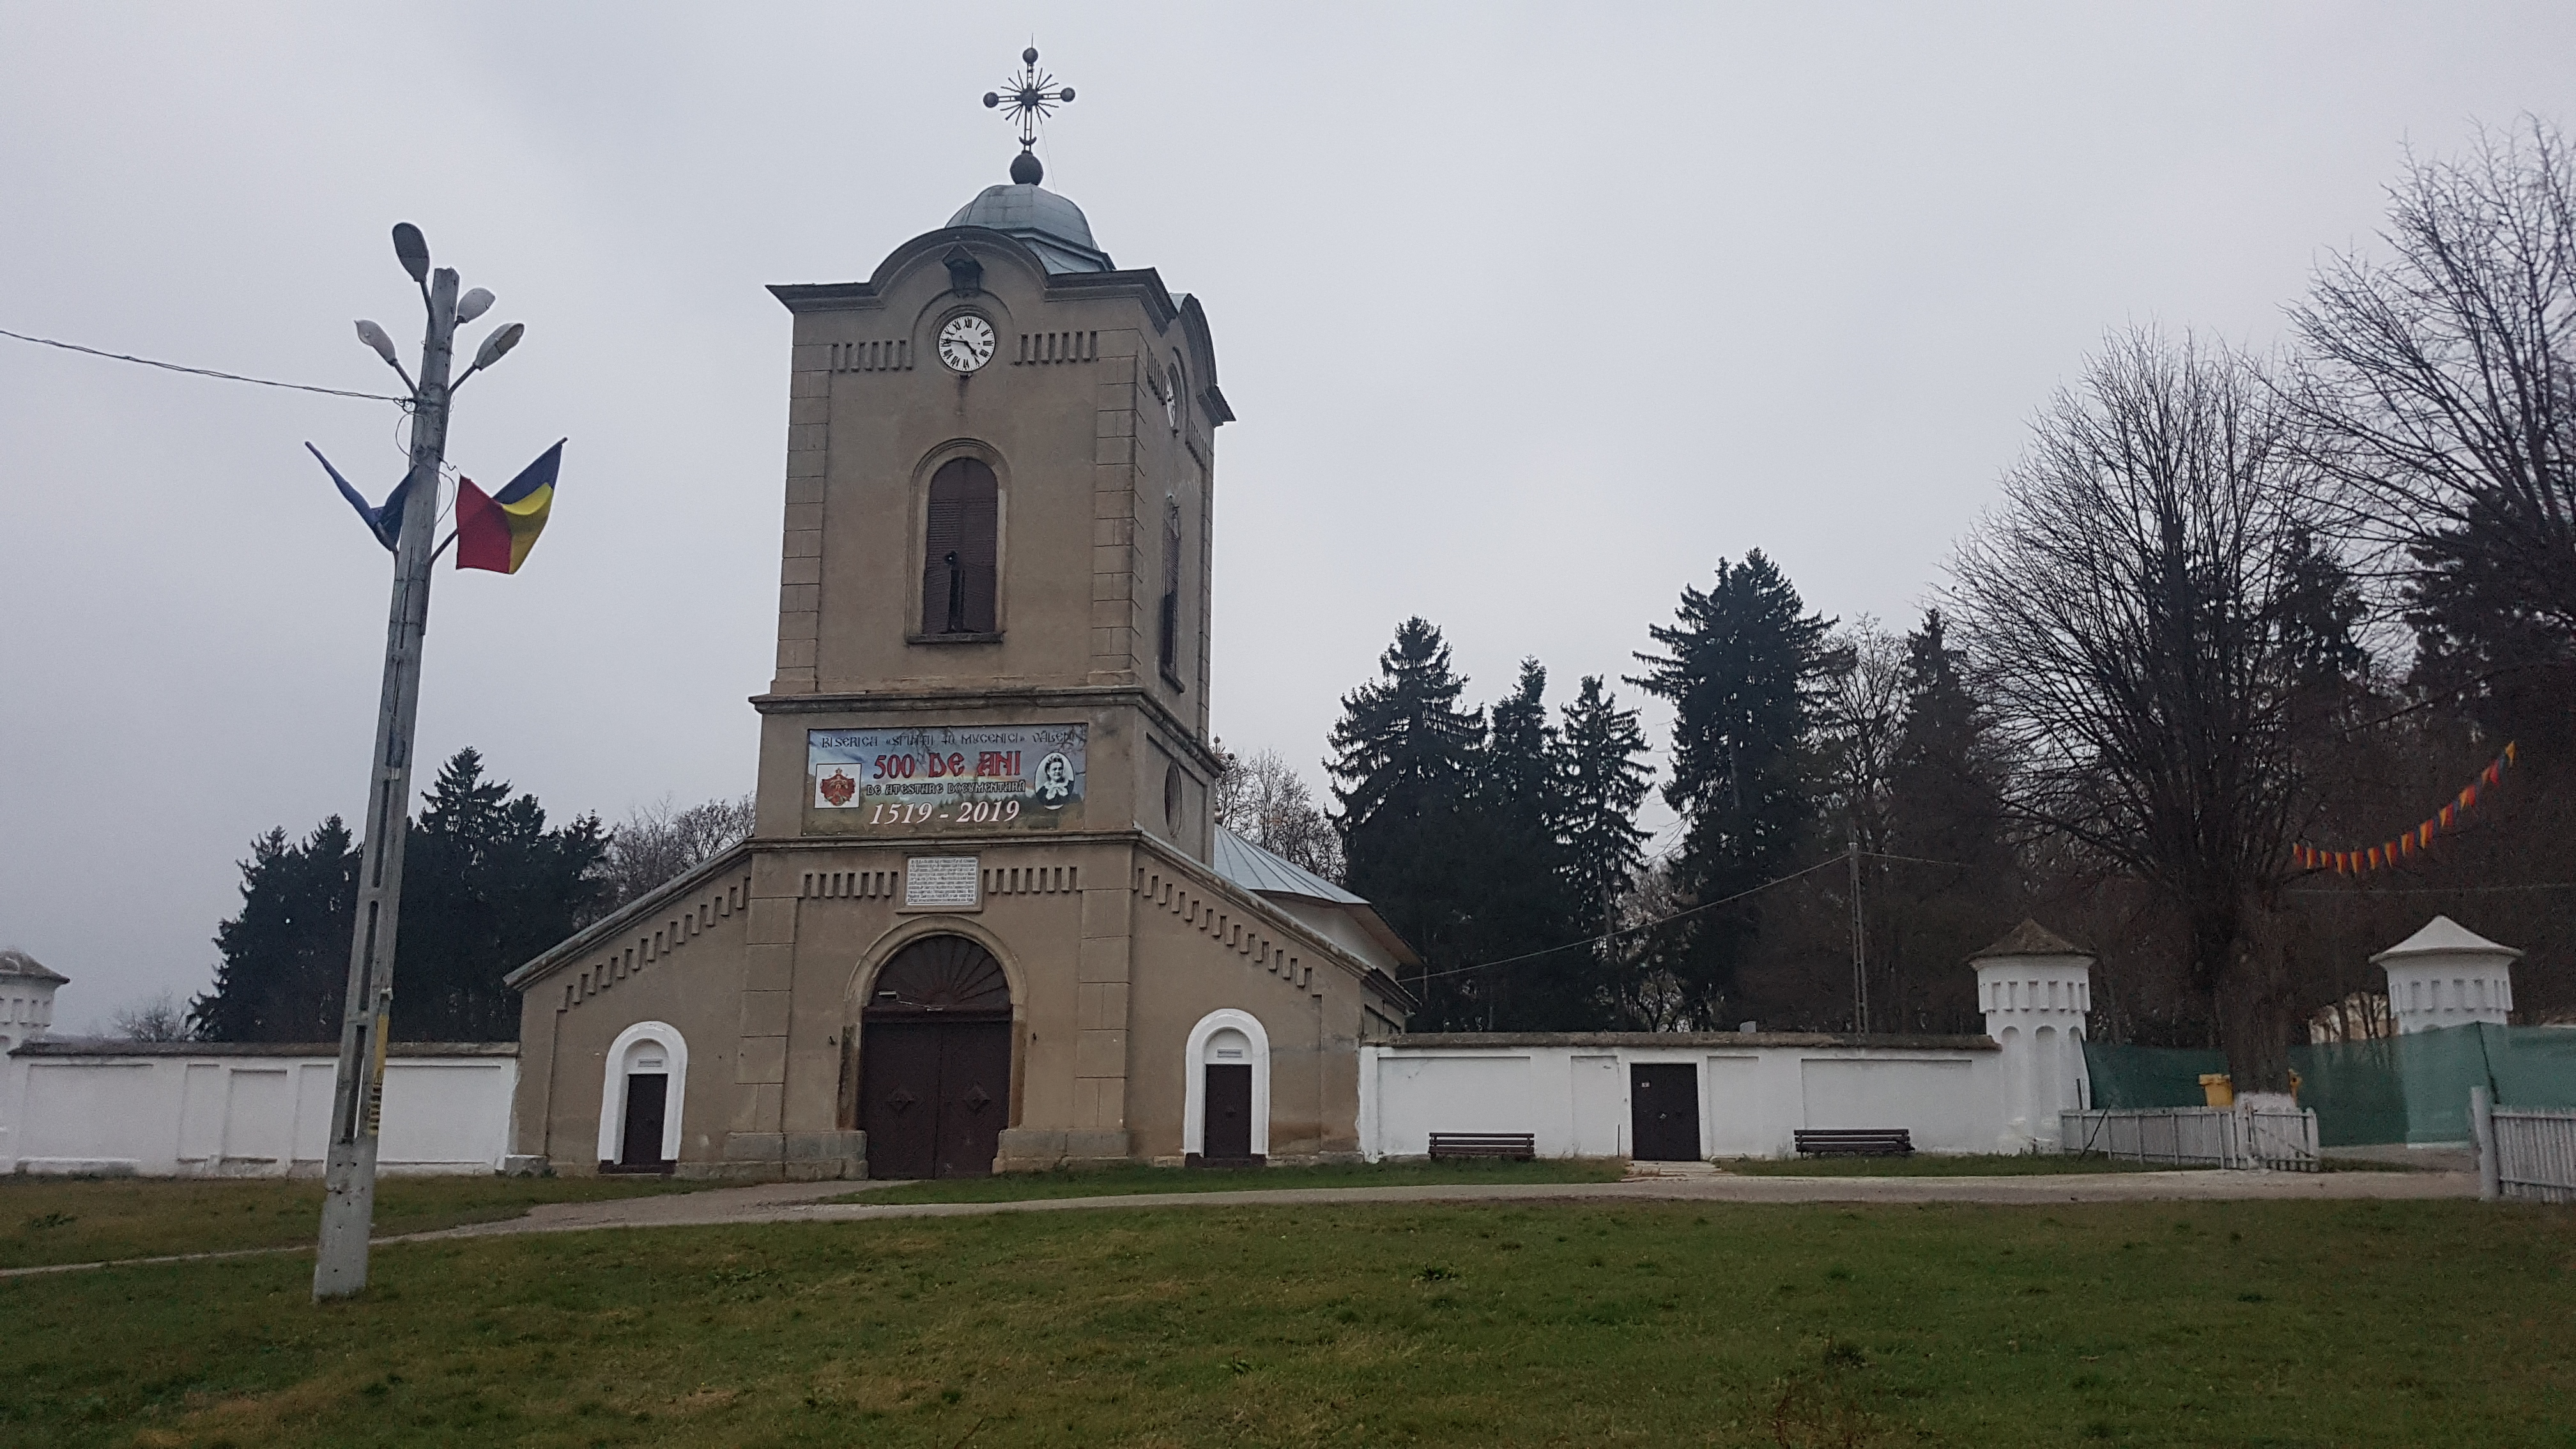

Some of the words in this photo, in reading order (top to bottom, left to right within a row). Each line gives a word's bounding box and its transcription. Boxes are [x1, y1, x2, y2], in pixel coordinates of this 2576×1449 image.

[822, 736, 878, 747] BISERICA
[873, 754, 916, 779] 500
[928, 752, 965, 778] DE
[977, 750, 1022, 777] ANI
[866, 785, 882, 796] DE
[885, 783, 944, 796] ATESTARE
[947, 779, 1026, 794] DOCUMENTARĂ
[870, 802, 933, 825] 1519
[956, 800, 1020, 823] 2019
